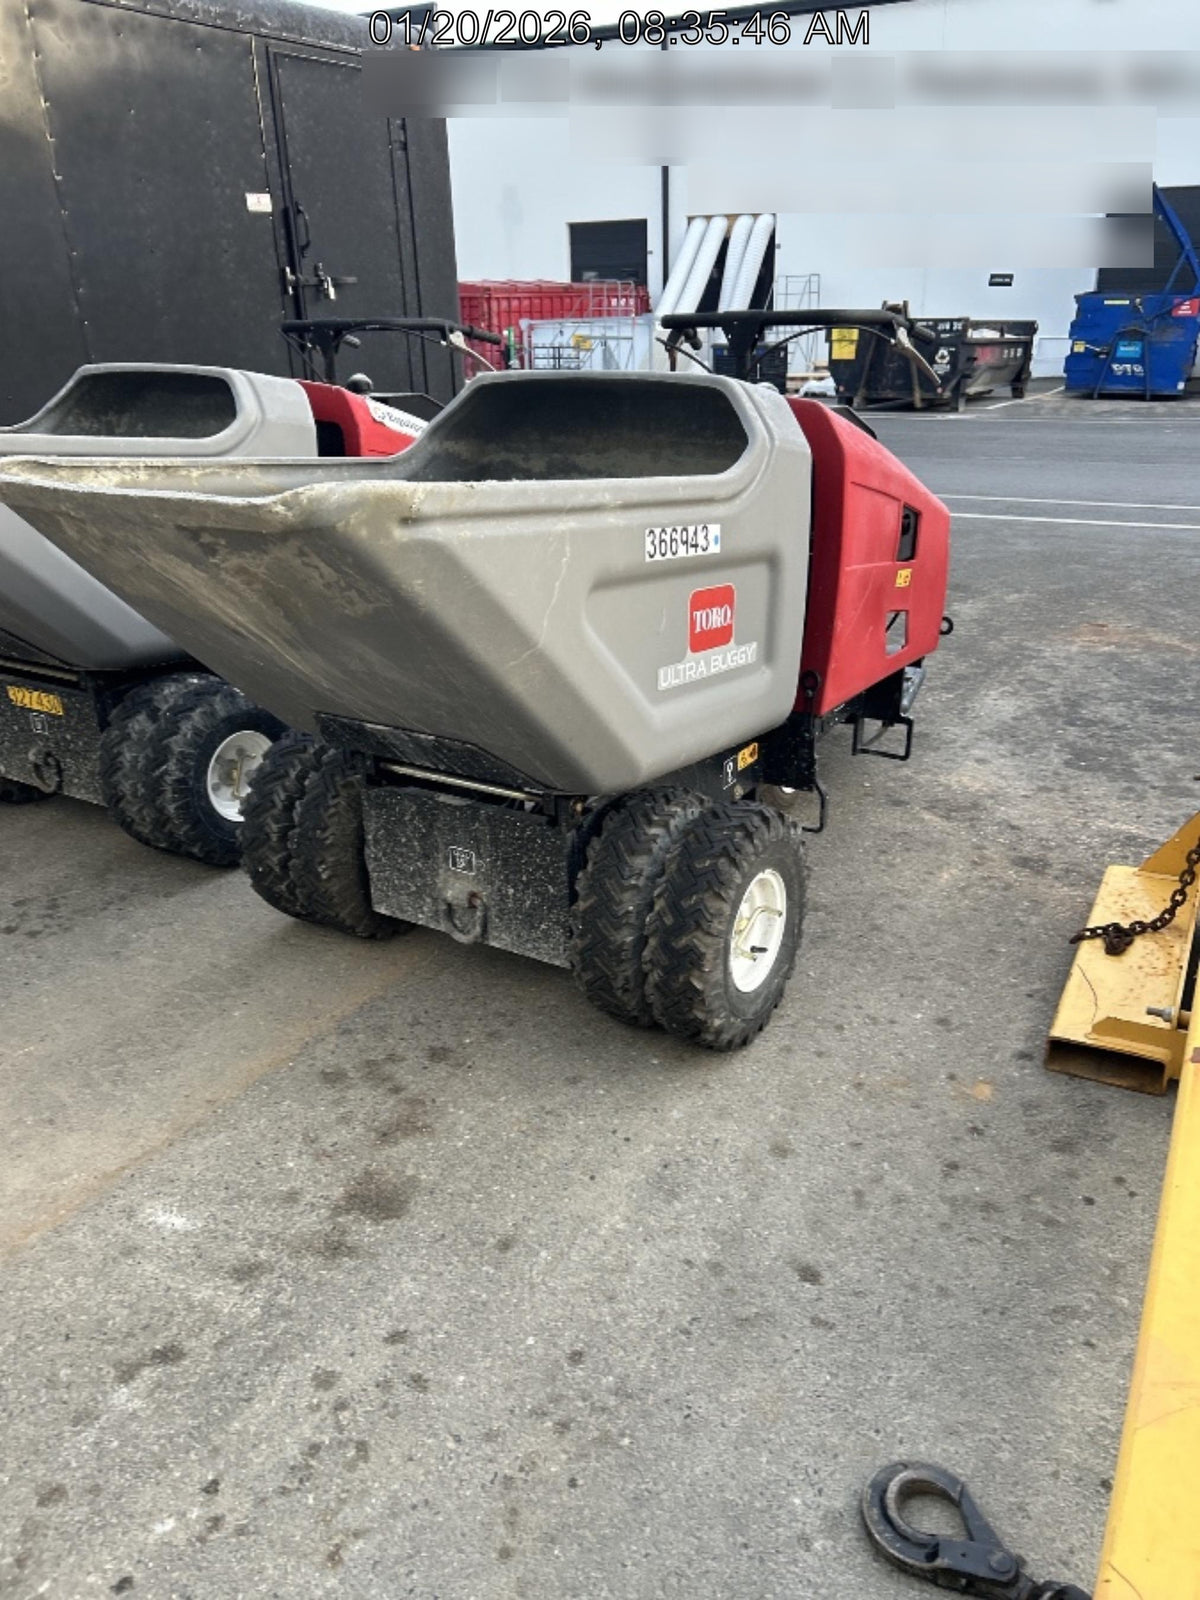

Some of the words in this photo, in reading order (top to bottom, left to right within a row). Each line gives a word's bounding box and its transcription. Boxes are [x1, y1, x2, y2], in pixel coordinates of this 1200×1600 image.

[646, 524, 711, 560] 366943
[692, 603, 733, 635] TORO
[658, 659, 707, 689] ULTRA
[710, 644, 755, 674] BUGGY
